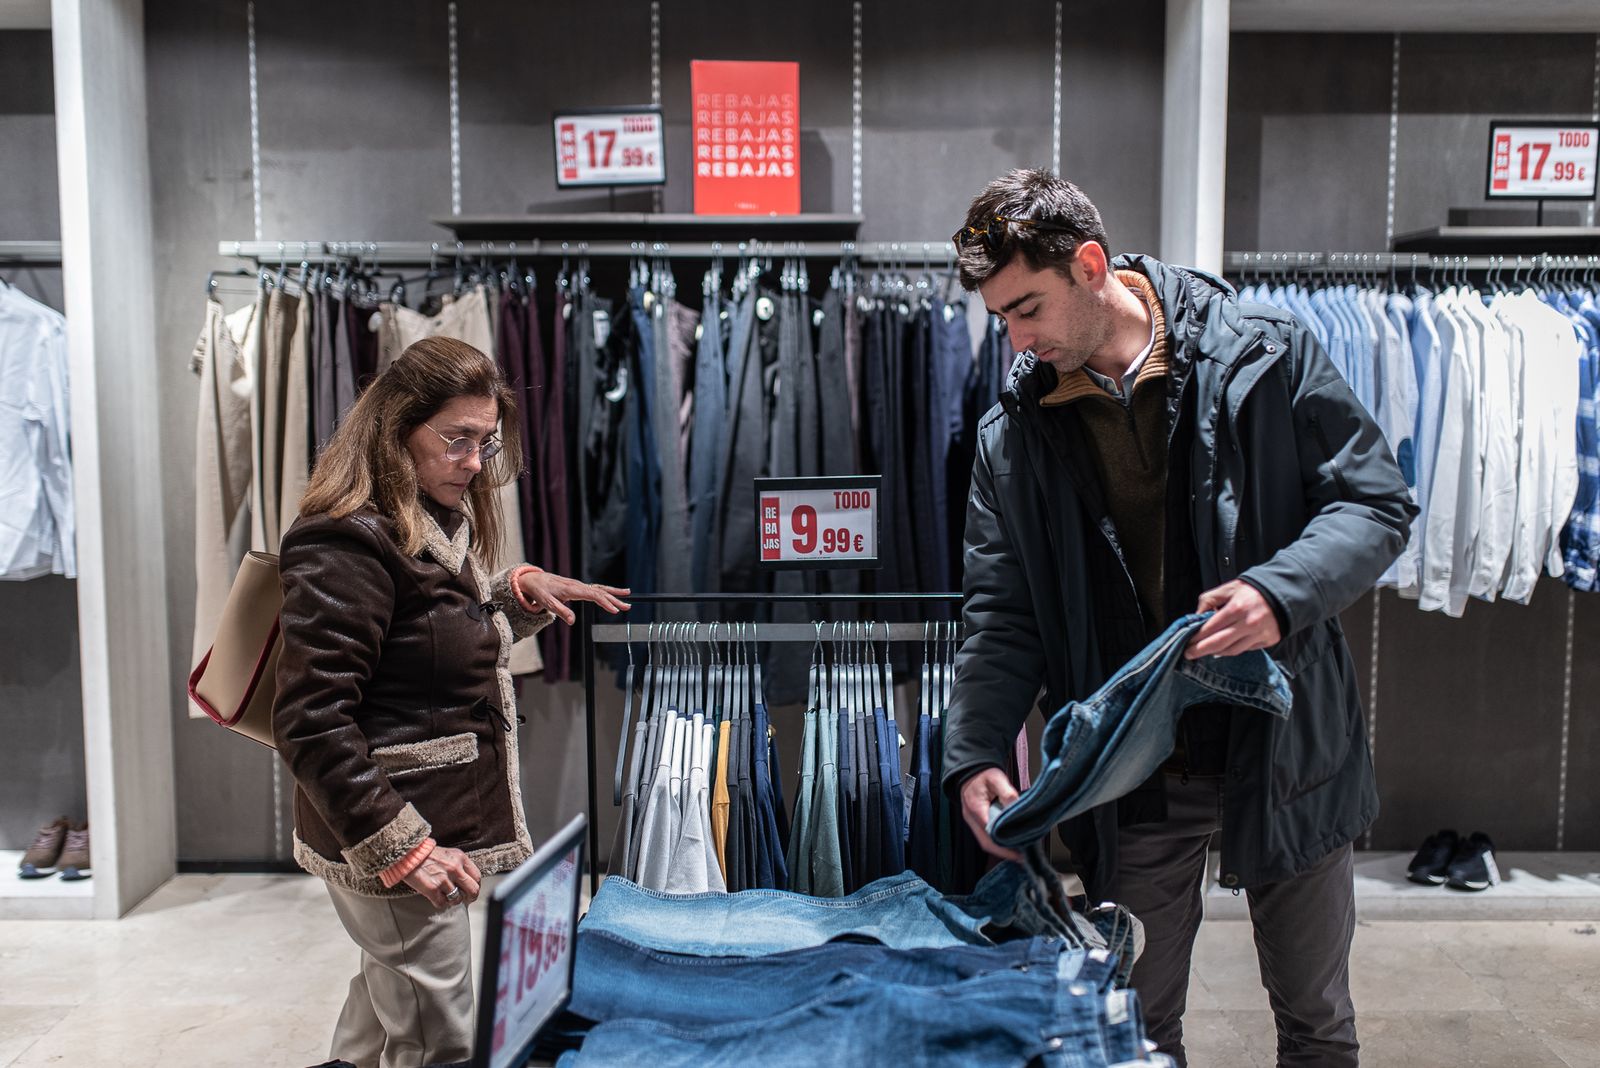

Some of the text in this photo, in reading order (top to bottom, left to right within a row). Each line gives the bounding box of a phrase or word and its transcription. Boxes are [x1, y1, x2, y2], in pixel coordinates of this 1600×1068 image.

[697, 94, 794, 109] REBAJAS
[697, 110, 794, 126] REBAJAS
[697, 127, 794, 142] REBAJAS
[1558, 132, 1590, 148] TODO
[697, 144, 794, 160] REBAJAS
[697, 162, 794, 178] REBAJAS
[833, 490, 871, 510] TODO
[765, 507, 777, 519] RE
[765, 522, 778, 535] BA
[763, 538, 780, 550] JAS
